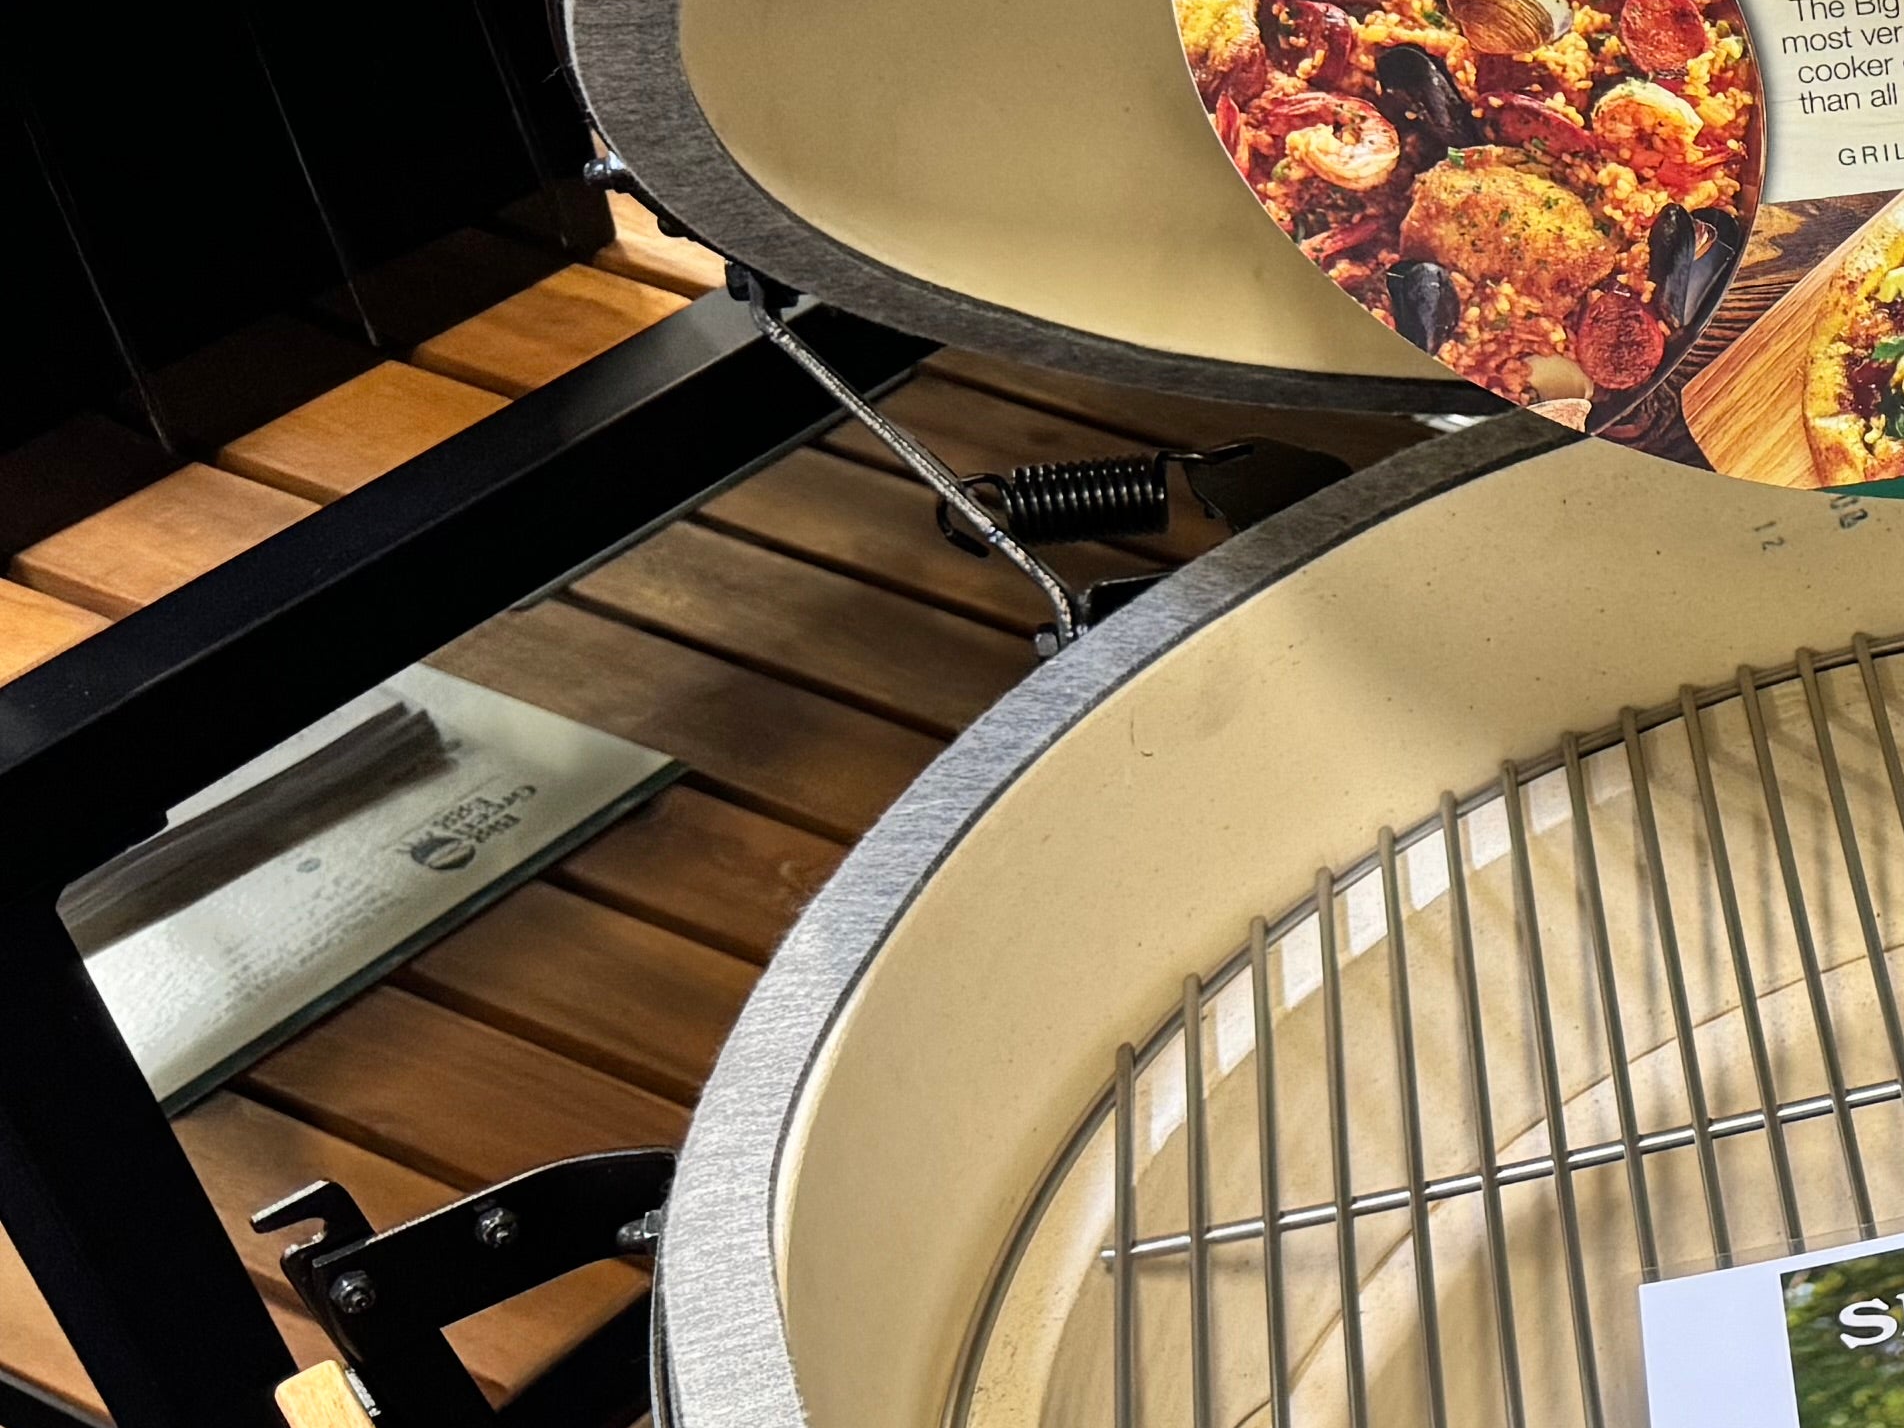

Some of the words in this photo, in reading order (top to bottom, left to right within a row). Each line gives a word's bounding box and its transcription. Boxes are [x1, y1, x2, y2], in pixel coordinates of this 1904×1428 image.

[1782, 26, 1854, 55] most
[1798, 55, 1894, 84] cooker
[1798, 90, 1861, 115] than
[1870, 82, 1899, 108] all
